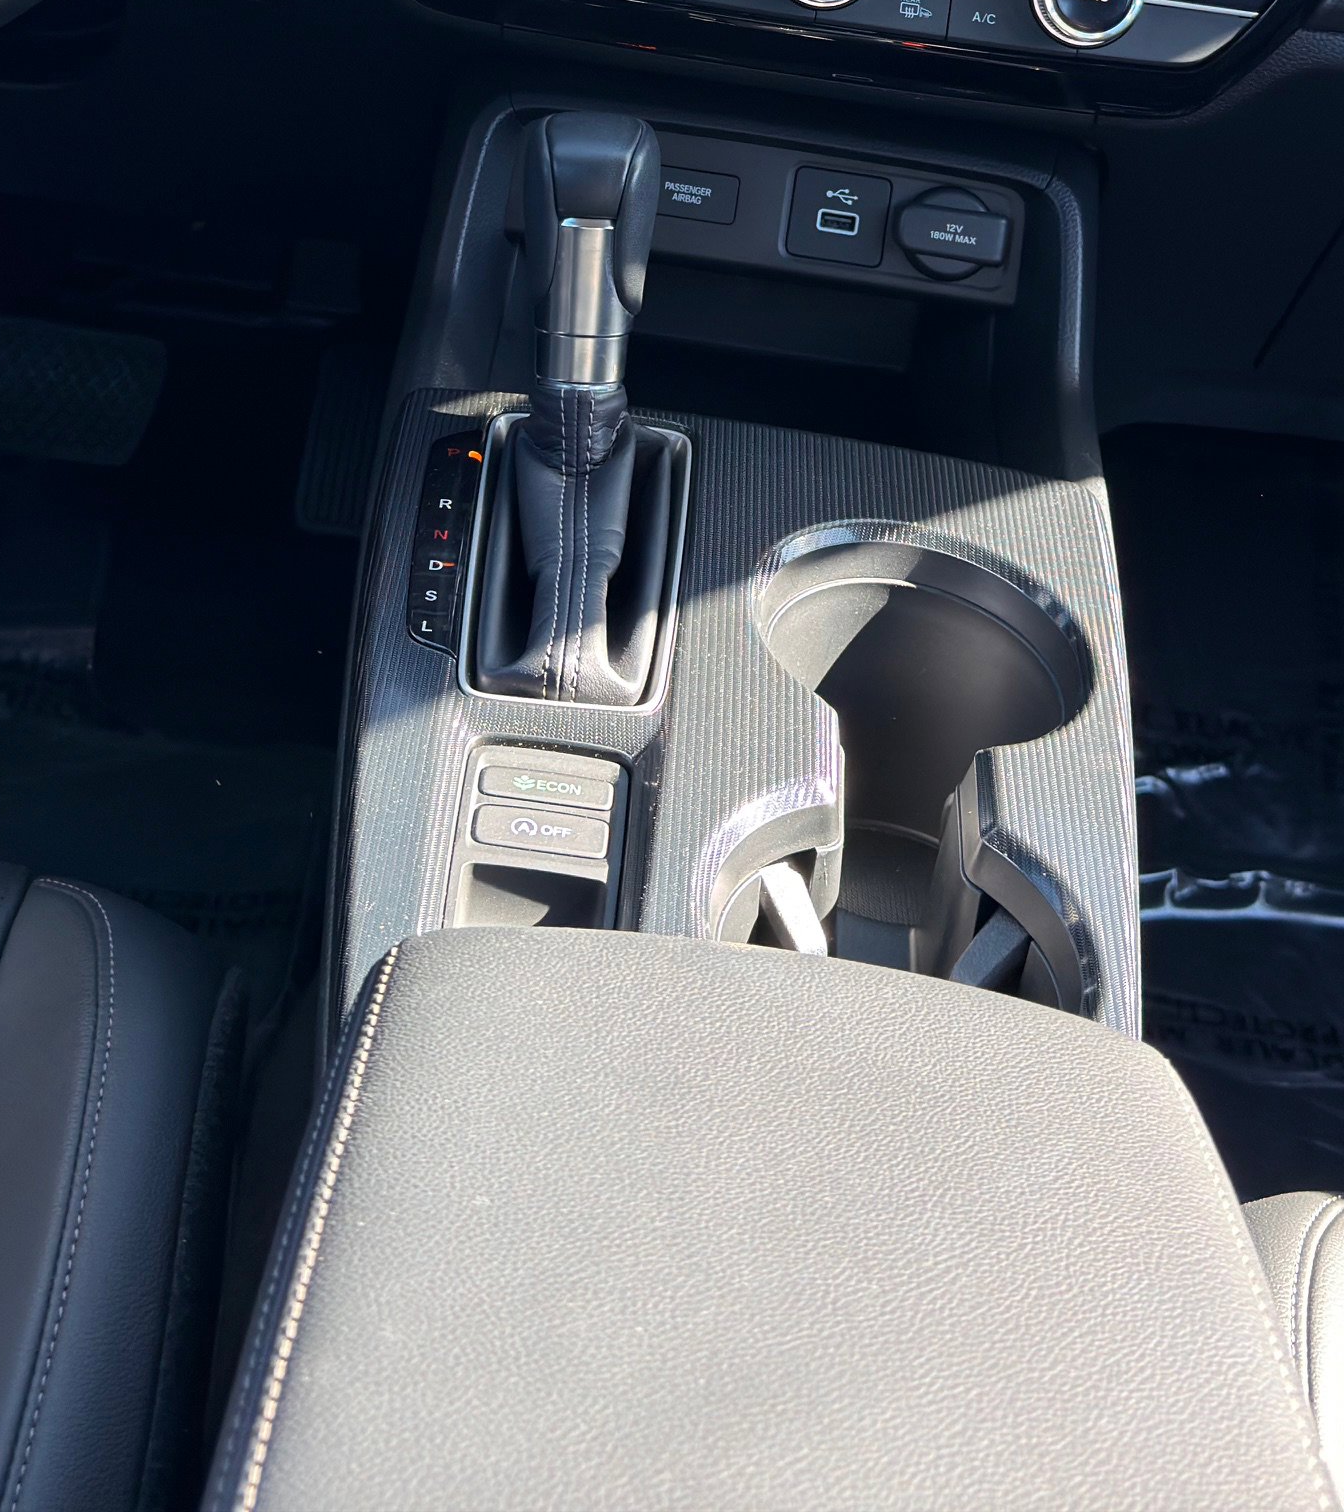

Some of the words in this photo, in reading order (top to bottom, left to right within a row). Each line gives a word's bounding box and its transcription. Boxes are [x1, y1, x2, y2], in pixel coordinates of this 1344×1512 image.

[971, 11, 997, 26] A/C
[664, 181, 712, 198] PASSENGER
[671, 192, 703, 207] AIRBAG
[945, 223, 964, 234] 12V
[929, 230, 954, 243] 180W
[954, 233, 977, 247] MAX
[447, 446, 461, 458] P
[439, 498, 453, 510] R
[433, 529, 449, 541] N
[428, 559, 444, 571] D
[425, 590, 438, 603] S
[421, 620, 433, 633] L
[536, 778, 582, 796] ECON
[540, 823, 572, 838] OFF
